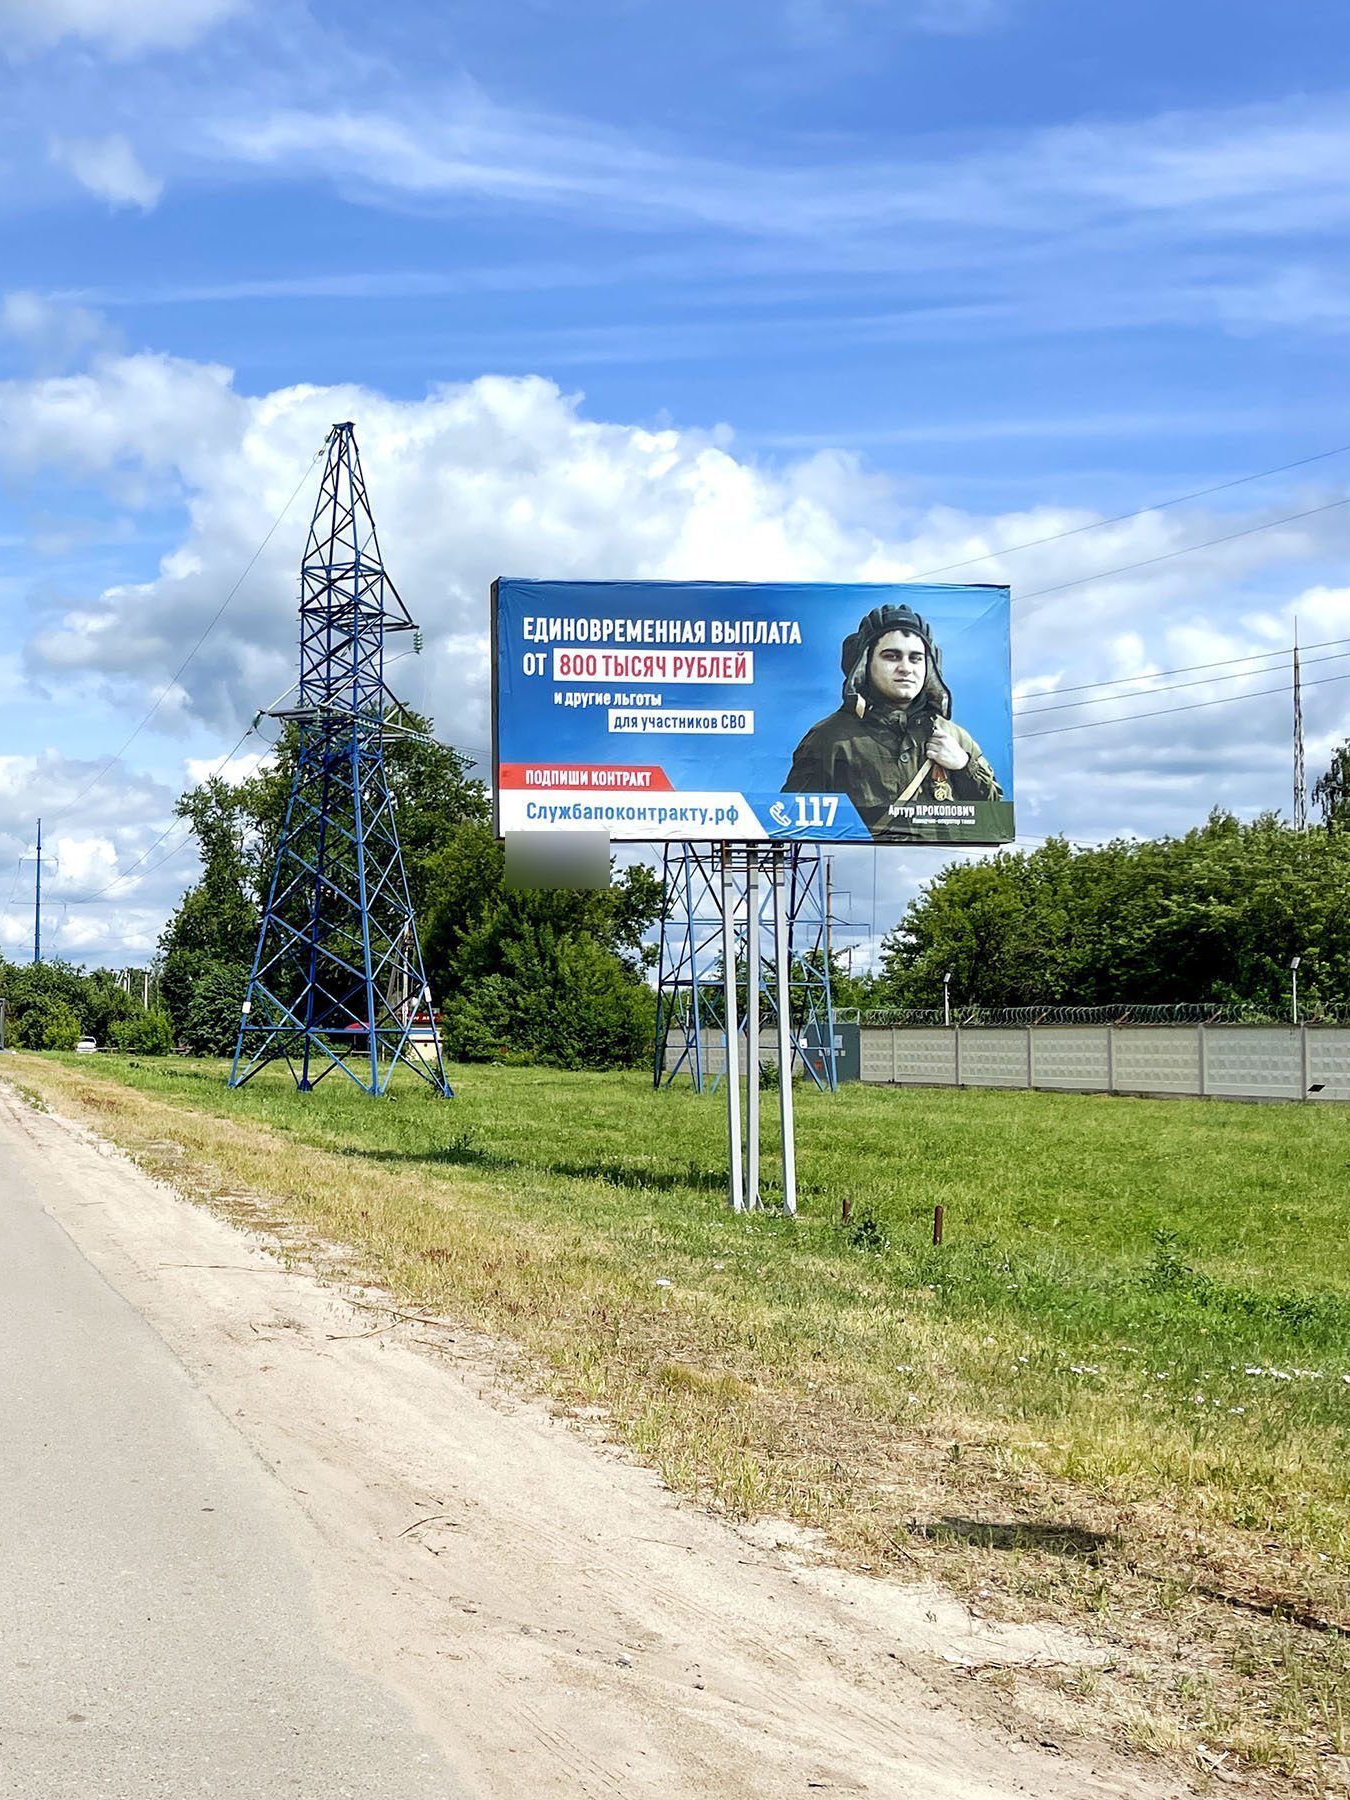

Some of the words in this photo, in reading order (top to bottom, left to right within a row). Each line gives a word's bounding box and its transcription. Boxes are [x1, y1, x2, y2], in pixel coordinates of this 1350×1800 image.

[522, 617, 706, 644] ЕДИНОВРЕМЕННАЯ
[710, 620, 803, 645] ВЫПЛАТА
[522, 652, 548, 677] ОТ
[559, 654, 597, 676] 800
[601, 655, 666, 678] ТЫСЯЧ
[672, 652, 747, 679] РУБЛЕЙ
[553, 692, 563, 705] и
[564, 692, 612, 708] другие
[613, 693, 662, 706] льготы
[614, 716, 638, 730] для
[641, 716, 718, 732] участников
[721, 714, 746, 729] СВО
[525, 769, 588, 786] ПОДПИШИ
[591, 771, 652, 787] КОНТРАКТ
[526, 802, 740, 825] Службапоконтракту.рф
[795, 796, 839, 827] 117
[888, 805, 915, 817] Артур
[916, 805, 975, 817] ПРОКОПОВИЧ
